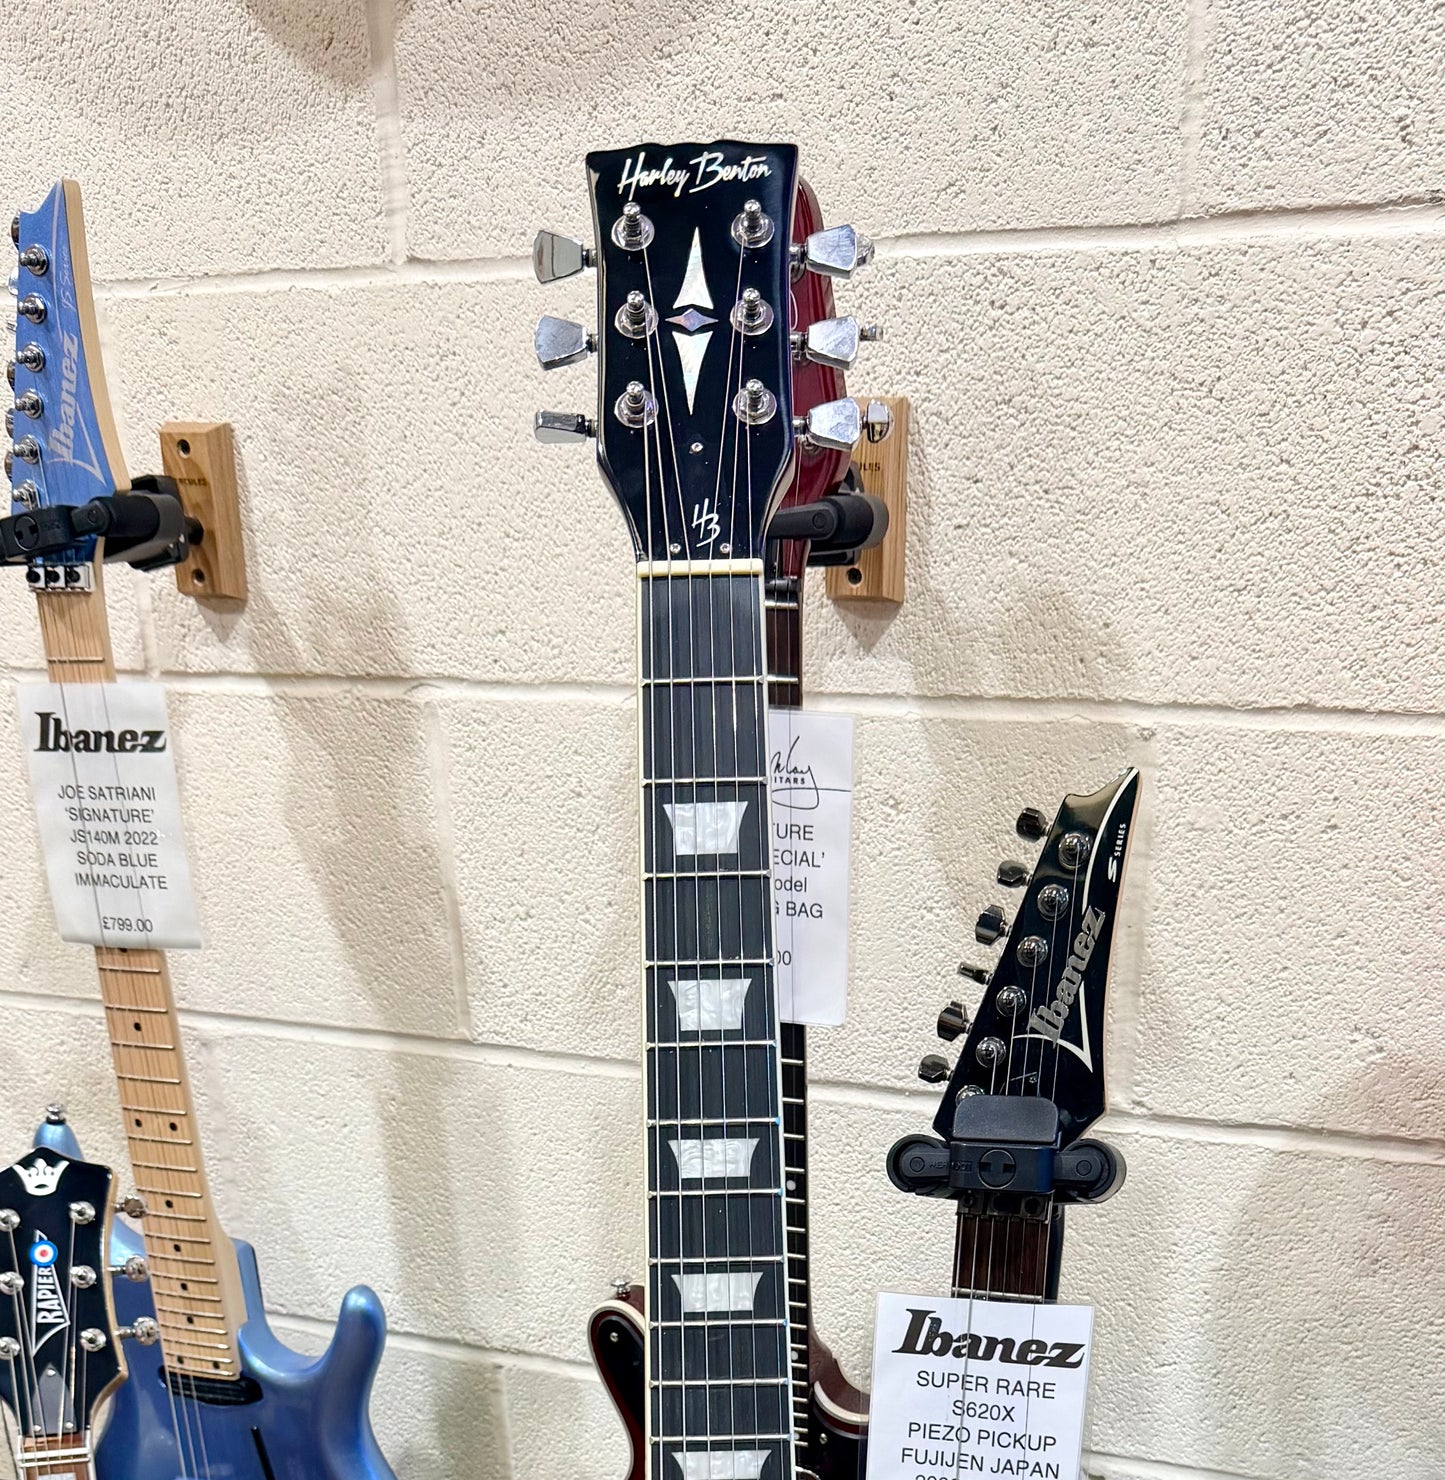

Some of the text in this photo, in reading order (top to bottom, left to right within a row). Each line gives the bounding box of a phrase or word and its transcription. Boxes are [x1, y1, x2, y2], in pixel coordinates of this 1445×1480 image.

[617, 151, 772, 201] Harley Benton
[50, 331, 78, 465] Ibanez
[34, 711, 167, 753] Ibanez
[58, 785, 156, 801] JOE SATRIANI
[772, 776, 806, 785] ITARS
[70, 830, 158, 846] JS140M 2022
[773, 824, 814, 841] URE
[1113, 823, 1127, 857] SERIES
[77, 851, 157, 868] SODA BLUE
[75, 873, 168, 890] IMMACULATE
[786, 901, 823, 919] BAG
[103, 917, 153, 933] £799.00
[1027, 905, 1106, 1048] Ibanez
[37, 1267, 65, 1324] RAPIER
[892, 1308, 1086, 1369] Ibanez
[916, 1370, 1056, 1399] SUPER RARE
[952, 1400, 1015, 1422] S620X
[908, 1422, 1057, 1452] PIEZO PICKUP
[901, 1448, 1060, 1480] FUJIJEN JAPAN
